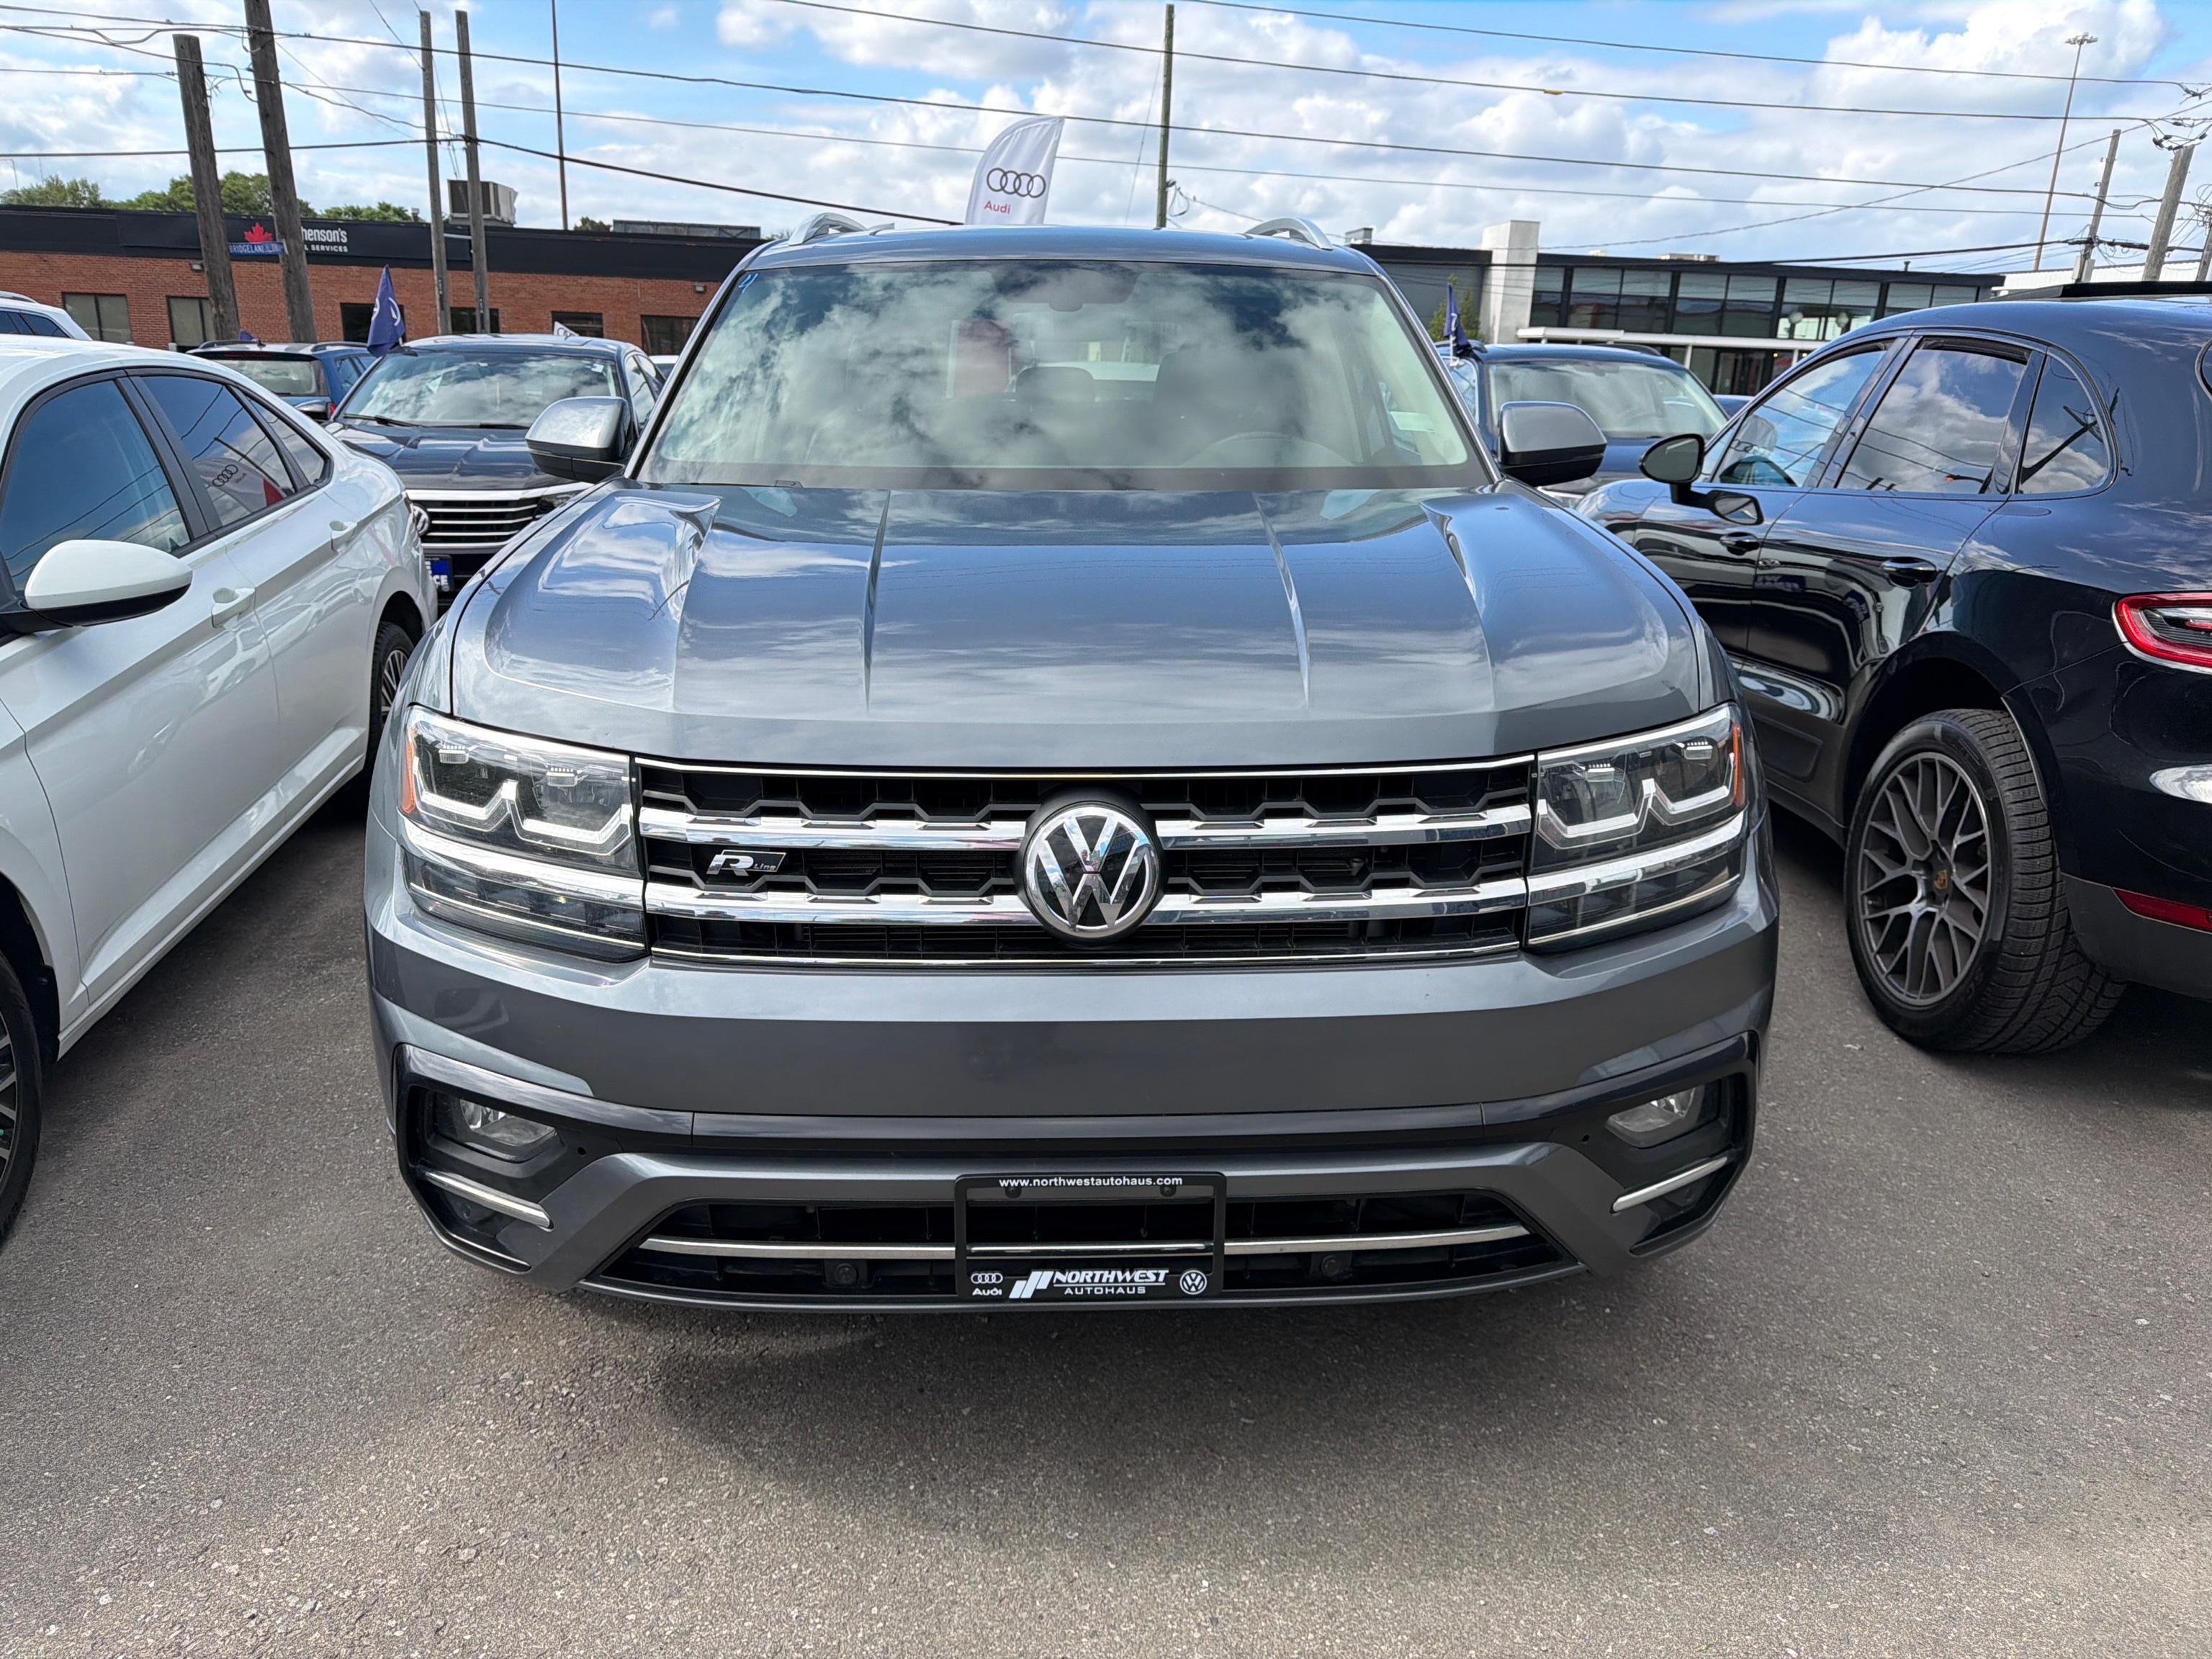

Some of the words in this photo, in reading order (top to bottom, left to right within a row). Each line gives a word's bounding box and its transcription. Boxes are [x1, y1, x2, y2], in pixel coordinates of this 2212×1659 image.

[984, 201, 1011, 214] Audi
[300, 225, 349, 243] henson's
[310, 244, 349, 253] SERVICES
[999, 1177, 1183, 1187] www.northwestautohaus.com
[1053, 1269, 1169, 1284] NORTHWEST
[971, 1287, 1002, 1296] Audi
[1064, 1287, 1146, 1295] AUTOHAUS
